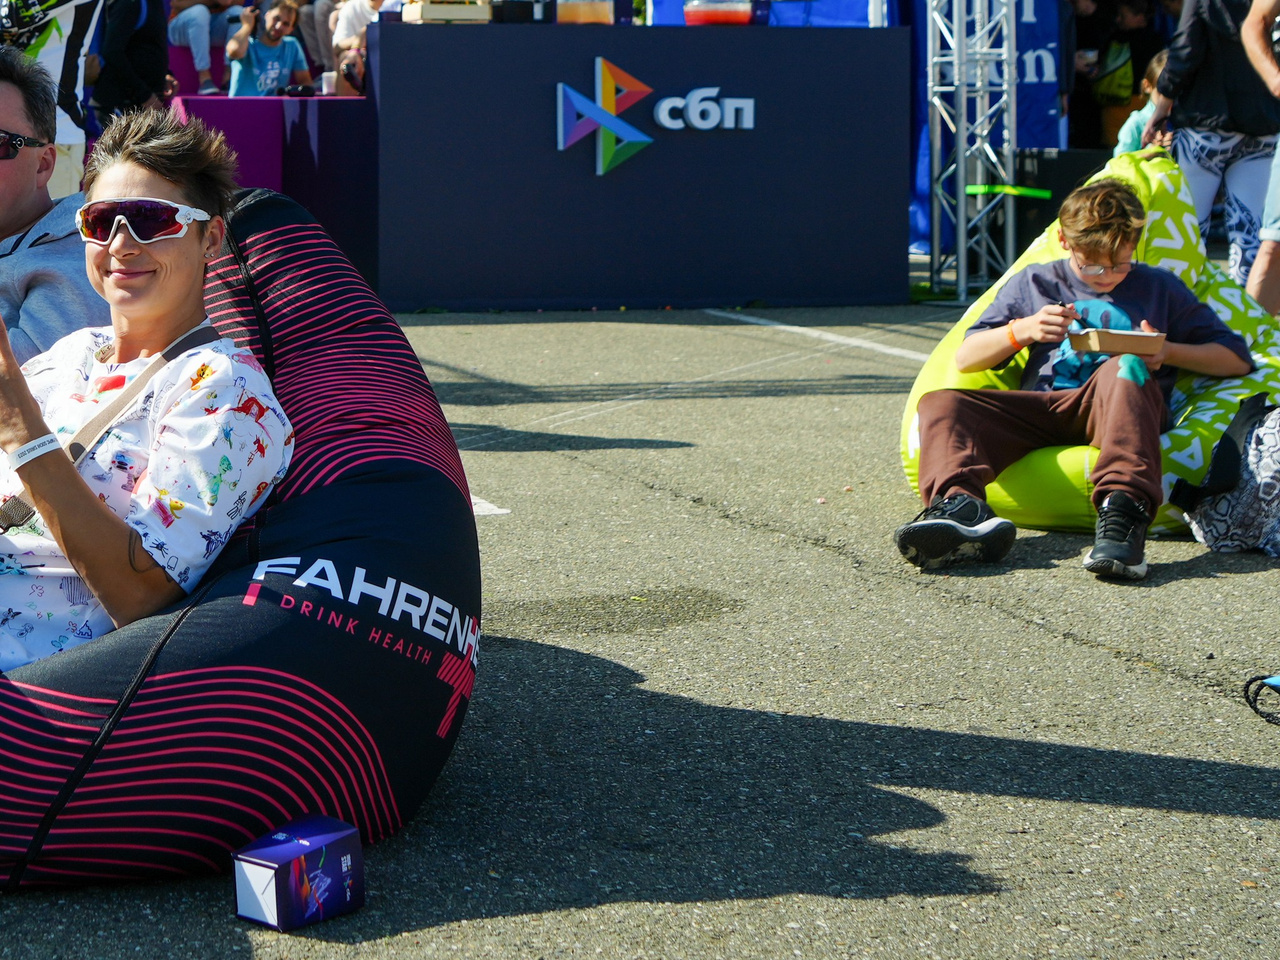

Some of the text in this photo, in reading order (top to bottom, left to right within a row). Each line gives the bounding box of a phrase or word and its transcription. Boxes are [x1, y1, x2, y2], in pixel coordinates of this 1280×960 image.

[653, 86, 756, 131] сбп
[280, 594, 433, 665] DRINK HEALTH
